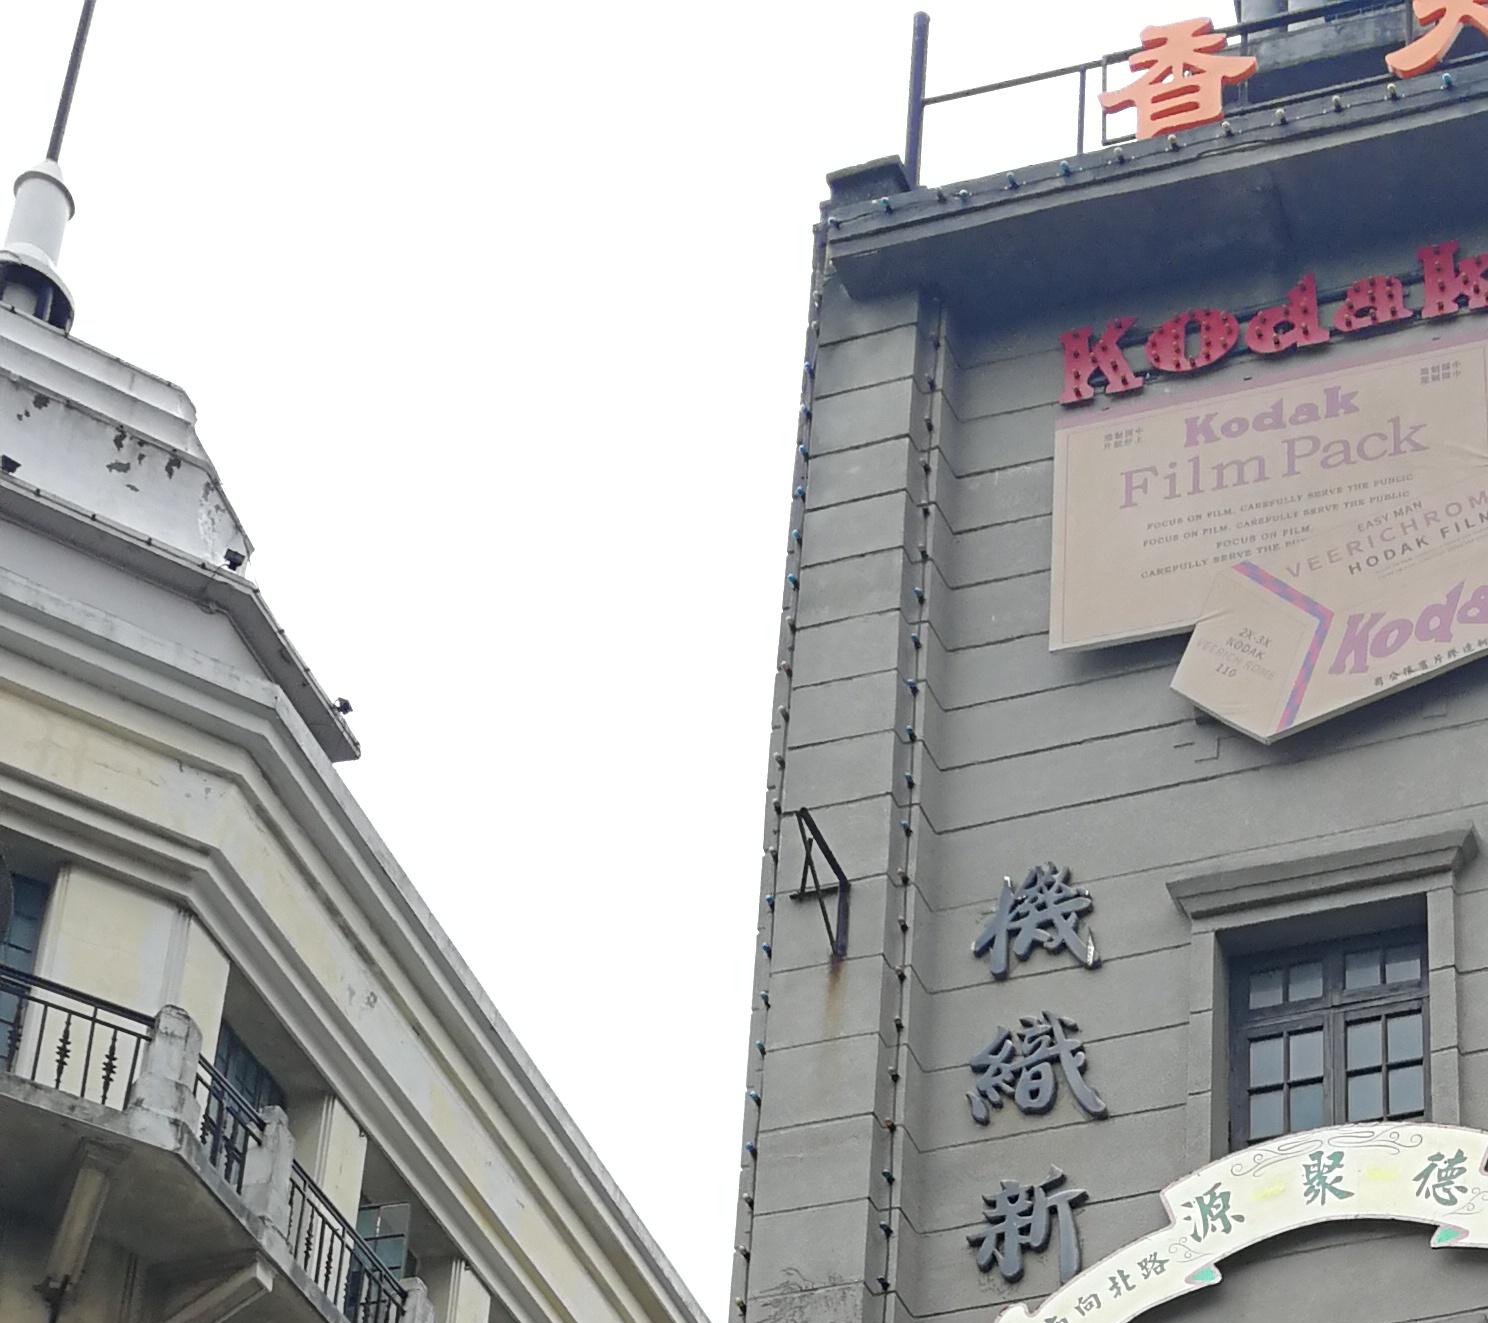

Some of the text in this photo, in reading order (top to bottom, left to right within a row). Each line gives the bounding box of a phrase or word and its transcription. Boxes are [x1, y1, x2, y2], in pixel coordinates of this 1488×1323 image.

[1184, 386, 1361, 448] Kodak
[1118, 415, 1431, 510] Film Pack
[1307, 485, 1344, 500] SERVE
[1357, 500, 1423, 533] EASY MAN
